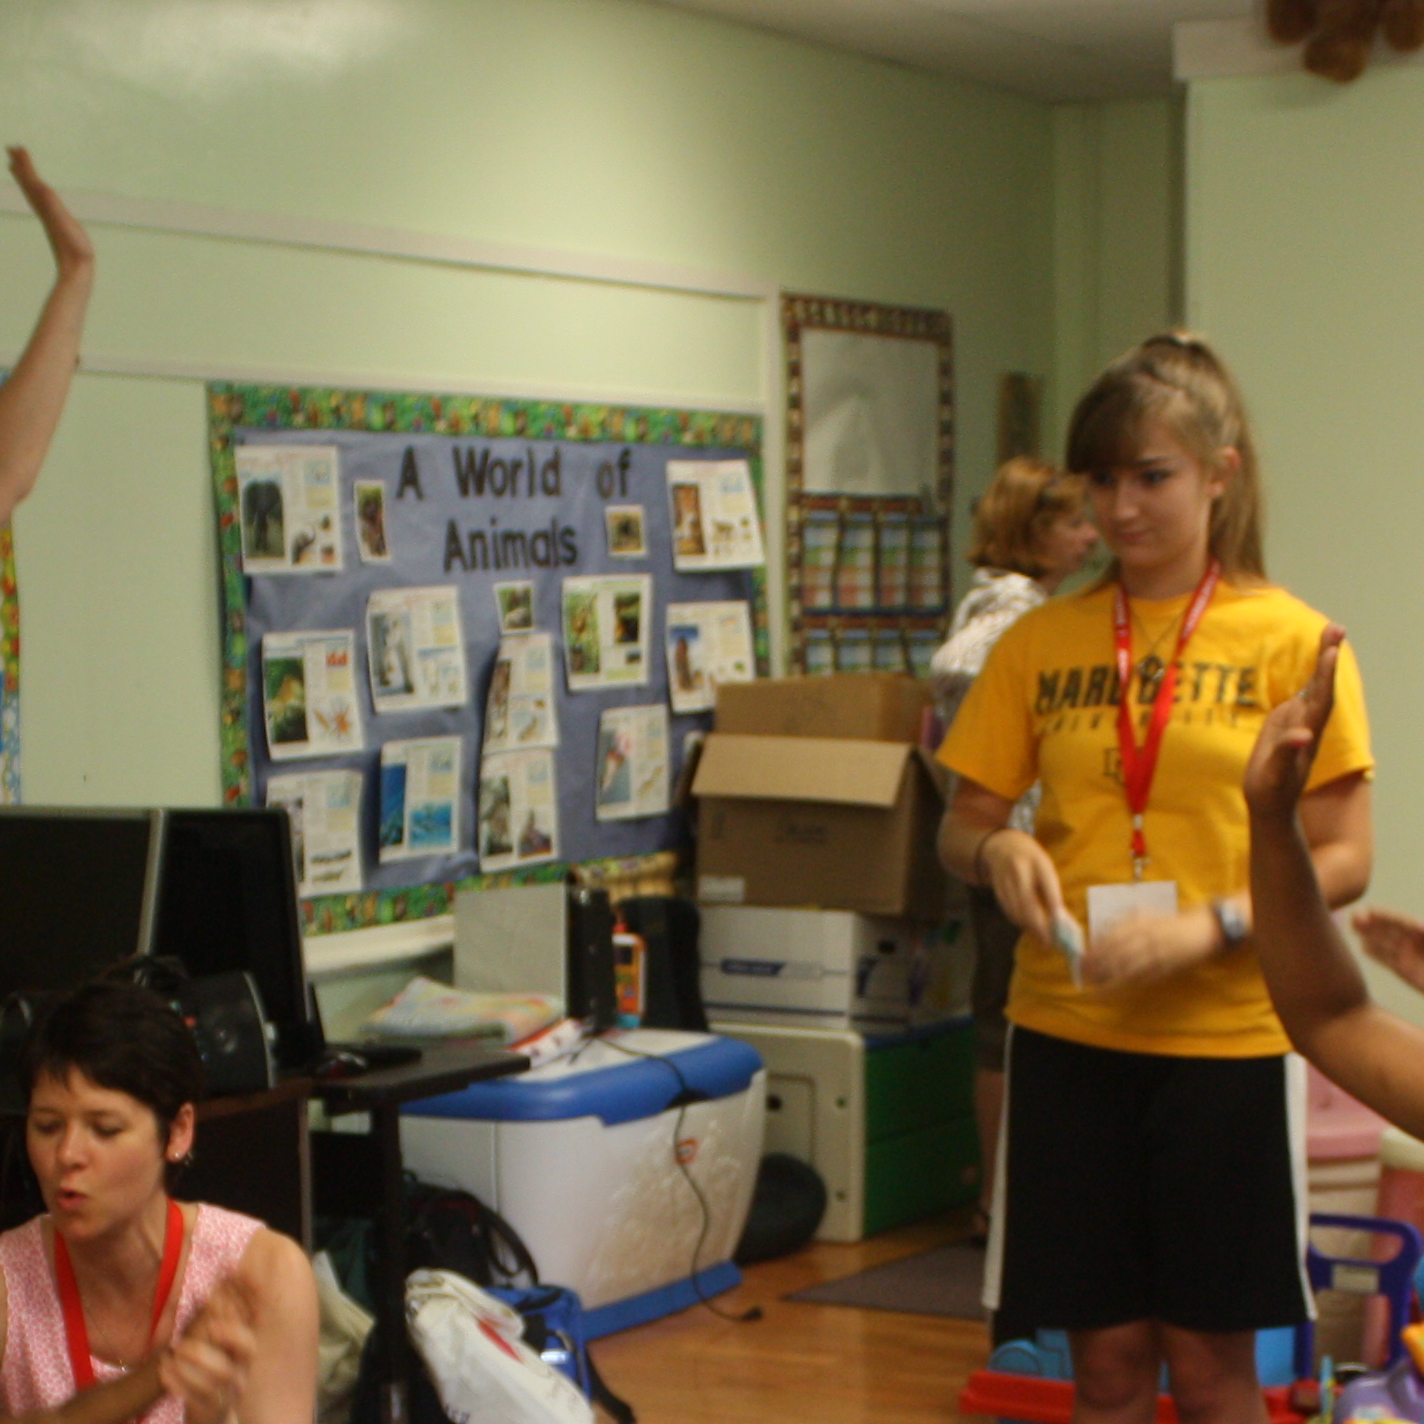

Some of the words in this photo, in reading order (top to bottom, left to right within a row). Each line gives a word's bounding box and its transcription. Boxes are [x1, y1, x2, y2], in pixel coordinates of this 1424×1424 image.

[396, 445, 424, 500] A
[452, 446, 562, 498] World
[596, 448, 633, 500] of
[443, 514, 579, 574] Animals
